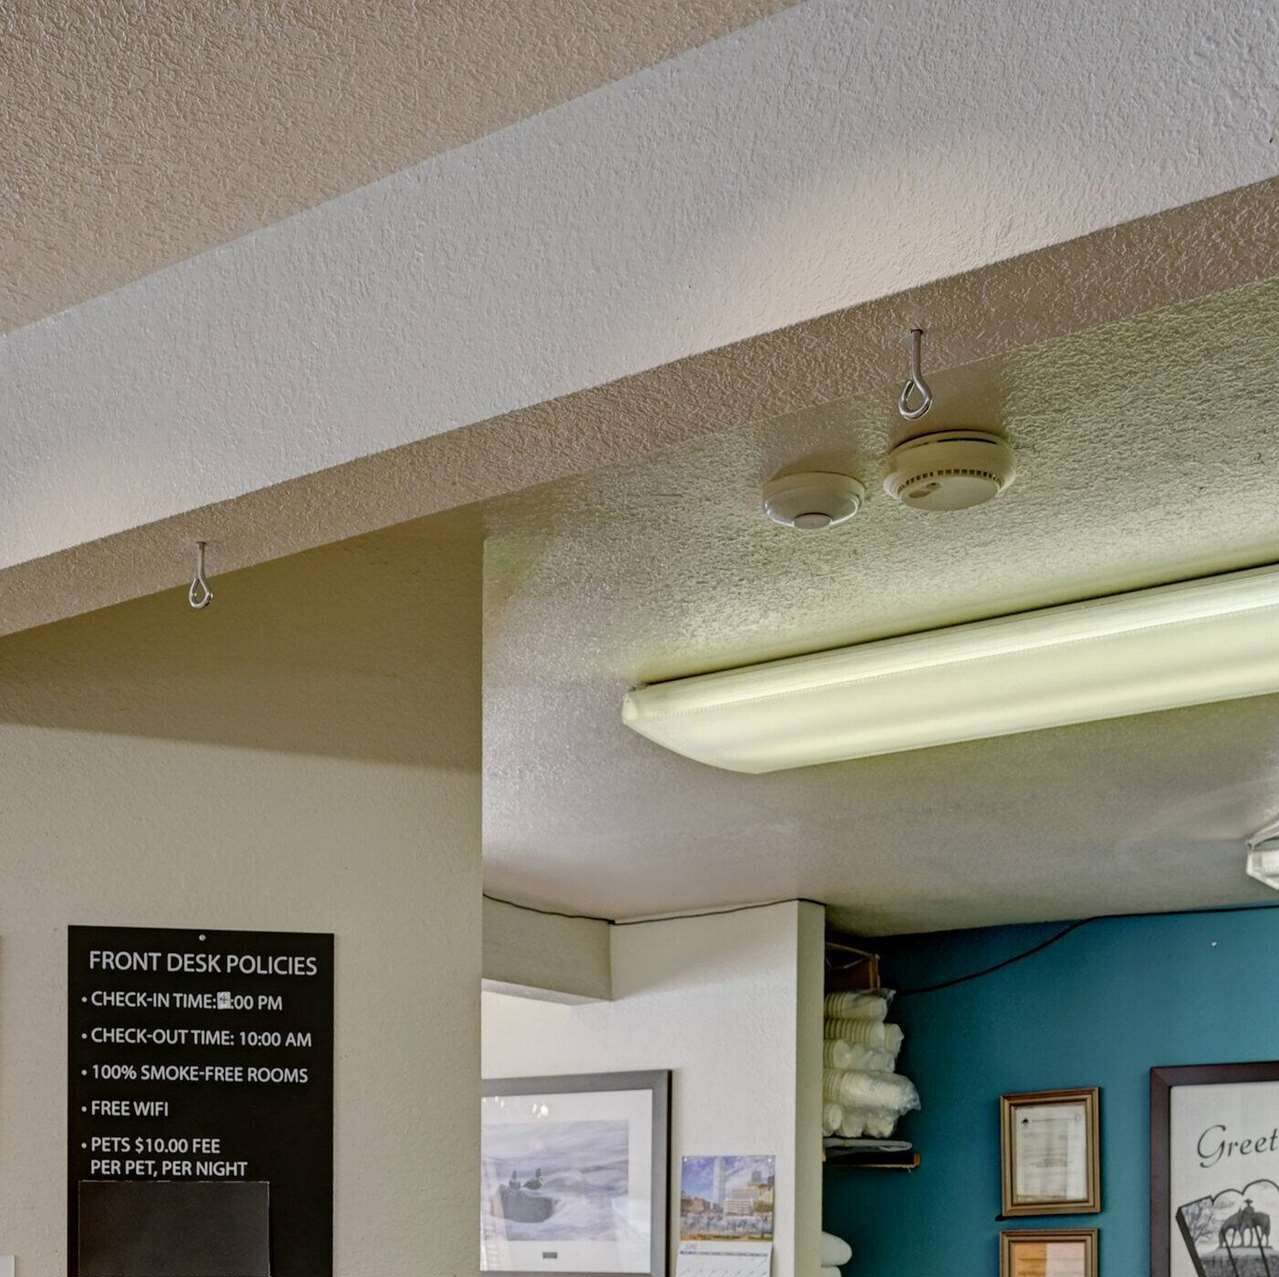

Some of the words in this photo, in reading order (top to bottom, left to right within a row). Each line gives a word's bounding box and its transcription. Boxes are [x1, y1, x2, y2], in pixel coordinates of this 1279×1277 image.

[89, 951, 162, 972] FRONT
[167, 953, 221, 974] DESK
[226, 955, 318, 976] POLICIES
[91, 991, 170, 1008] CHECK-IN
[173, 993, 217, 1010] TIME:
[258, 995, 283, 1011] PM
[91, 1027, 188, 1045] CHECK-OUT
[190, 1029, 235, 1046] TIME:
[239, 1031, 282, 1047] 10:00
[284, 1032, 312, 1048] AM
[92, 1064, 137, 1080] 100%
[140, 1065, 243, 1083] SMOKE-FREE
[247, 1067, 309, 1084] ROOMS
[91, 1100, 130, 1117] FREE
[133, 1101, 169, 1117] WIFI
[91, 1137, 130, 1153] PETS
[135, 1137, 188, 1156] $10.00
[192, 1138, 220, 1154] FEE
[90, 1159, 121, 1175] PER
[125, 1160, 158, 1178] PET,
[161, 1160, 192, 1176] PER
[195, 1161, 248, 1177] NIGHT
